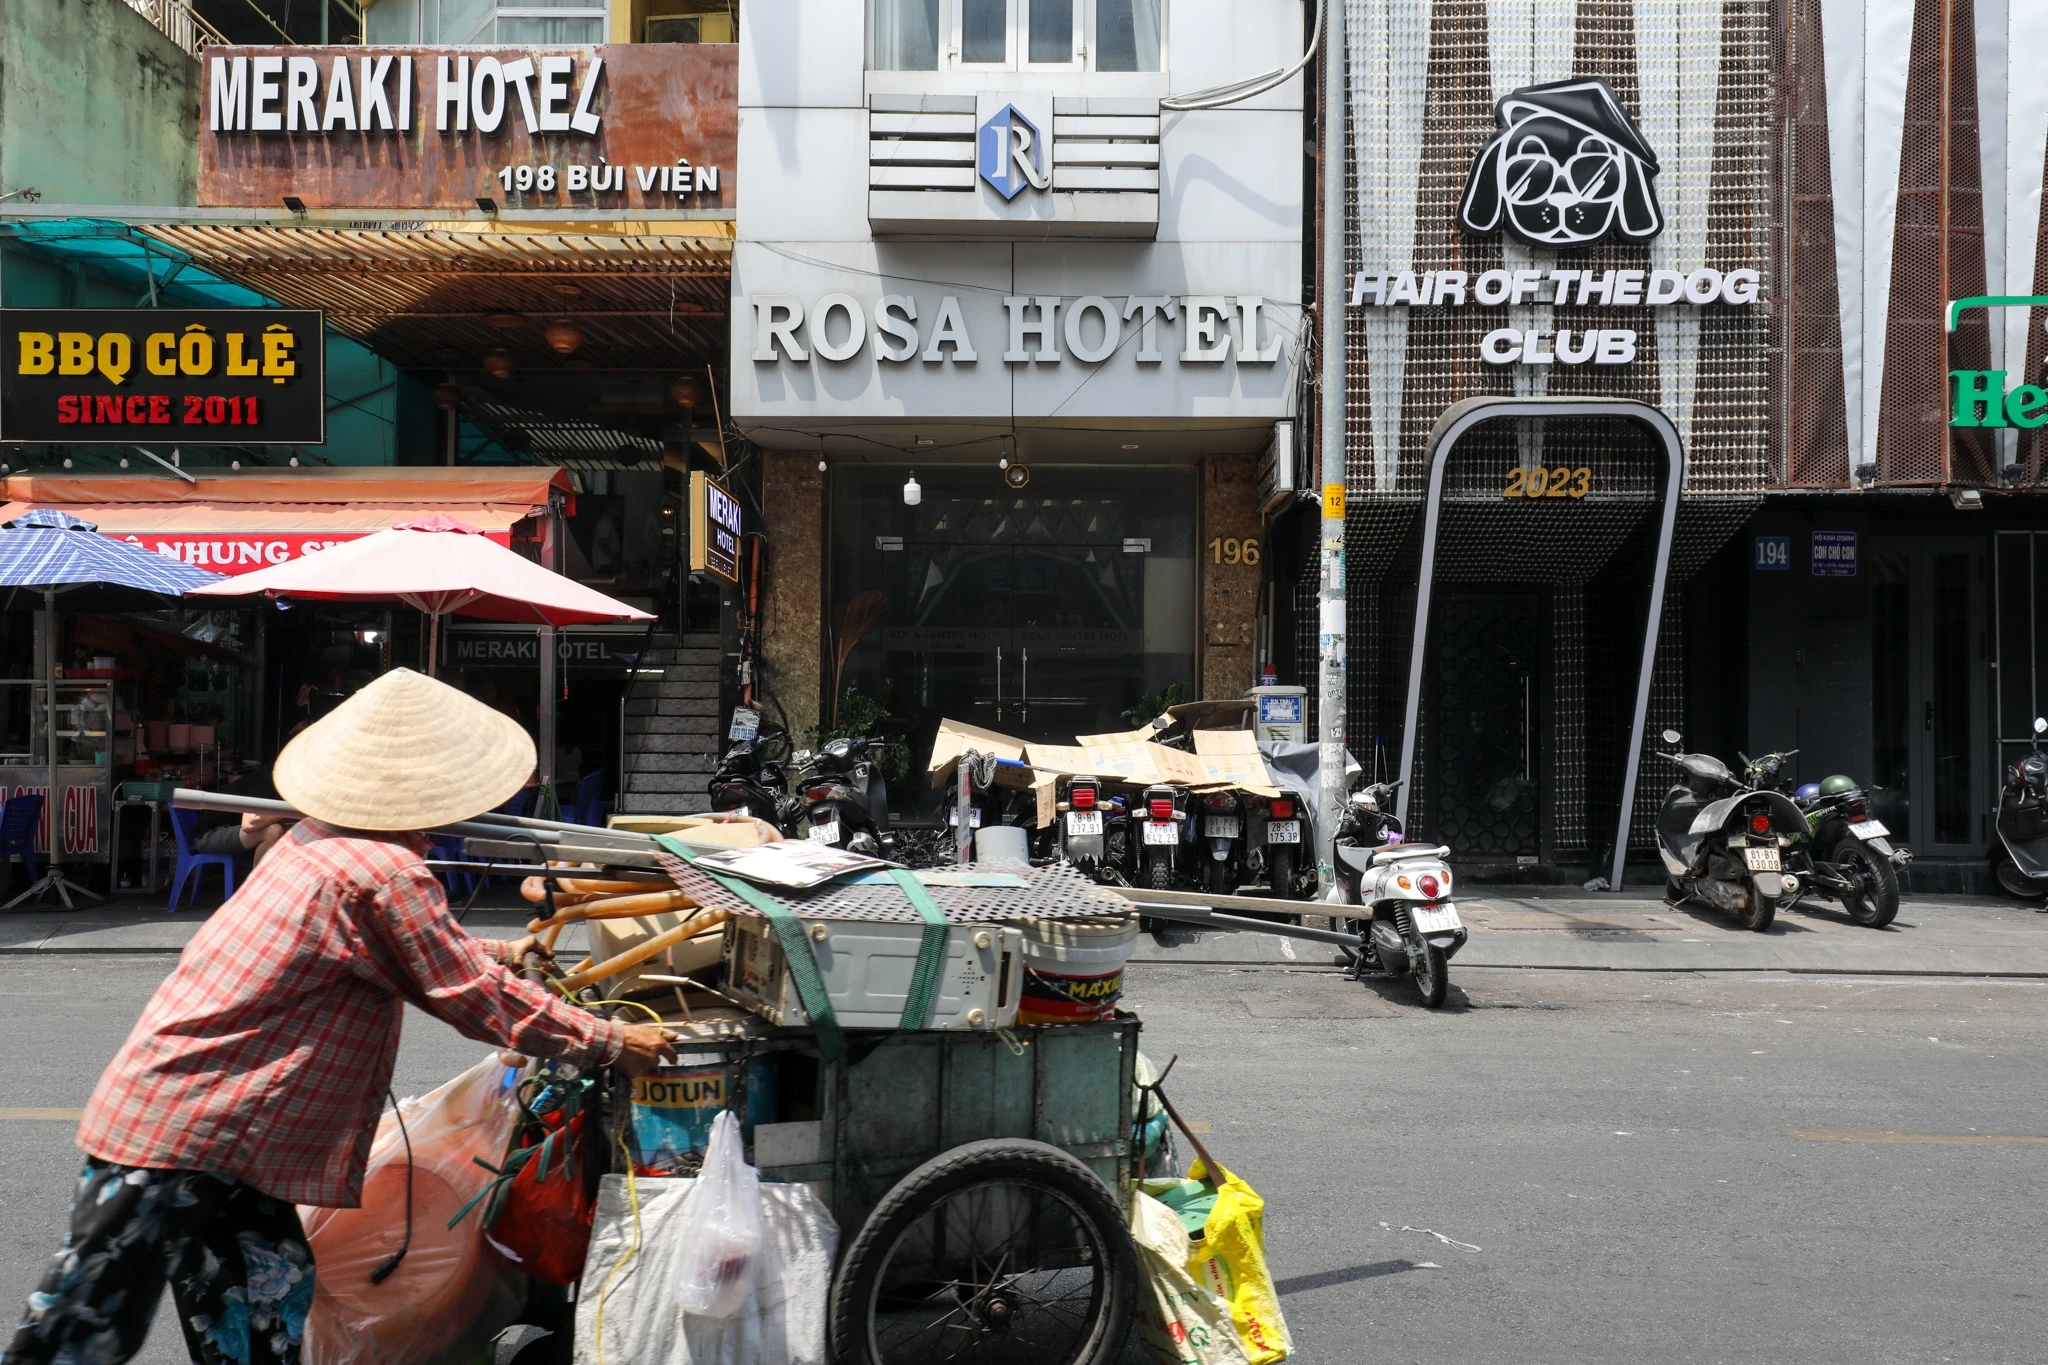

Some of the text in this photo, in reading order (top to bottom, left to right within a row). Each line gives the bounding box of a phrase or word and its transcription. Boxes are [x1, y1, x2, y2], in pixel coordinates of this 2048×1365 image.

[210, 55, 604, 137] MERAKI HOTEL
[499, 157, 719, 201] 198 BÙI VIỆN
[1352, 268, 1760, 306] HAIR OF THE DOG
[752, 293, 1283, 363] ROSA HOTEL
[18, 323, 296, 386] BBQ CÔ LỆ
[1481, 329, 1637, 364] CLUB
[57, 396, 259, 425] SINCE 2011
[1507, 467, 1591, 498] 2023
[709, 485, 742, 536] MERAKI
[1330, 496, 1341, 507] 12
[156, 541, 290, 565] NHUNG
[716, 529, 735, 555] HOTEL
[1208, 537, 1260, 566] 196
[1758, 541, 1787, 565] 194
[1814, 545, 1827, 560] CON
[1842, 546, 1855, 560] CON
[457, 640, 612, 659] MERAKI OTEL
[63, 785, 99, 854] CUA
[1269, 832, 1298, 842] 175.38
[1750, 859, 1779, 869] 130.08
[640, 1079, 720, 1103] JOTUN
